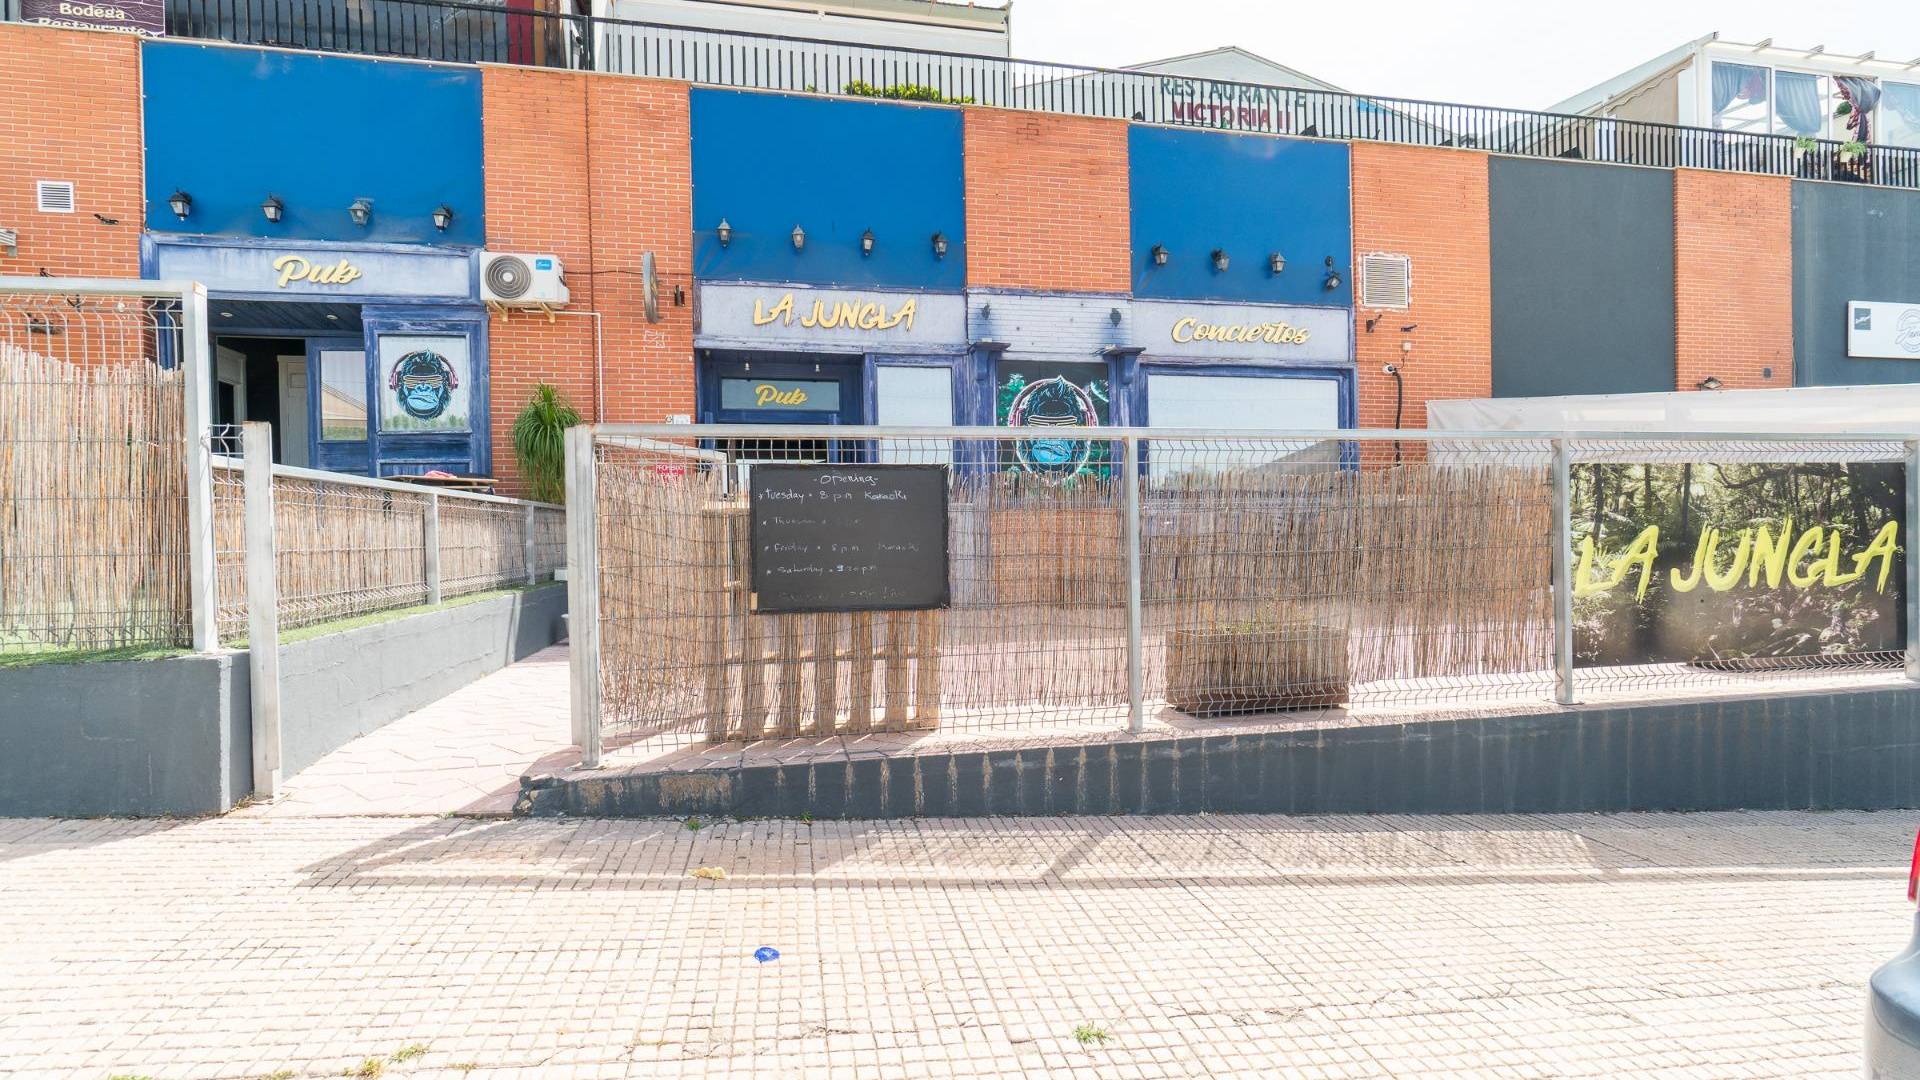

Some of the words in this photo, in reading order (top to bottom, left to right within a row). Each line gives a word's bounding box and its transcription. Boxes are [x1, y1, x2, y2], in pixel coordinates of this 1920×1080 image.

[59, 3, 125, 19] Bodega
[1172, 101, 1271, 129] VICTORIA
[272, 255, 362, 288] Pub
[753, 292, 793, 327] LA
[801, 297, 916, 332] JUNGLA
[1172, 316, 1311, 345] Conciertos
[755, 384, 808, 407] Pub
[1574, 524, 1659, 605] LA
[1671, 514, 1898, 595] JUNGLA
